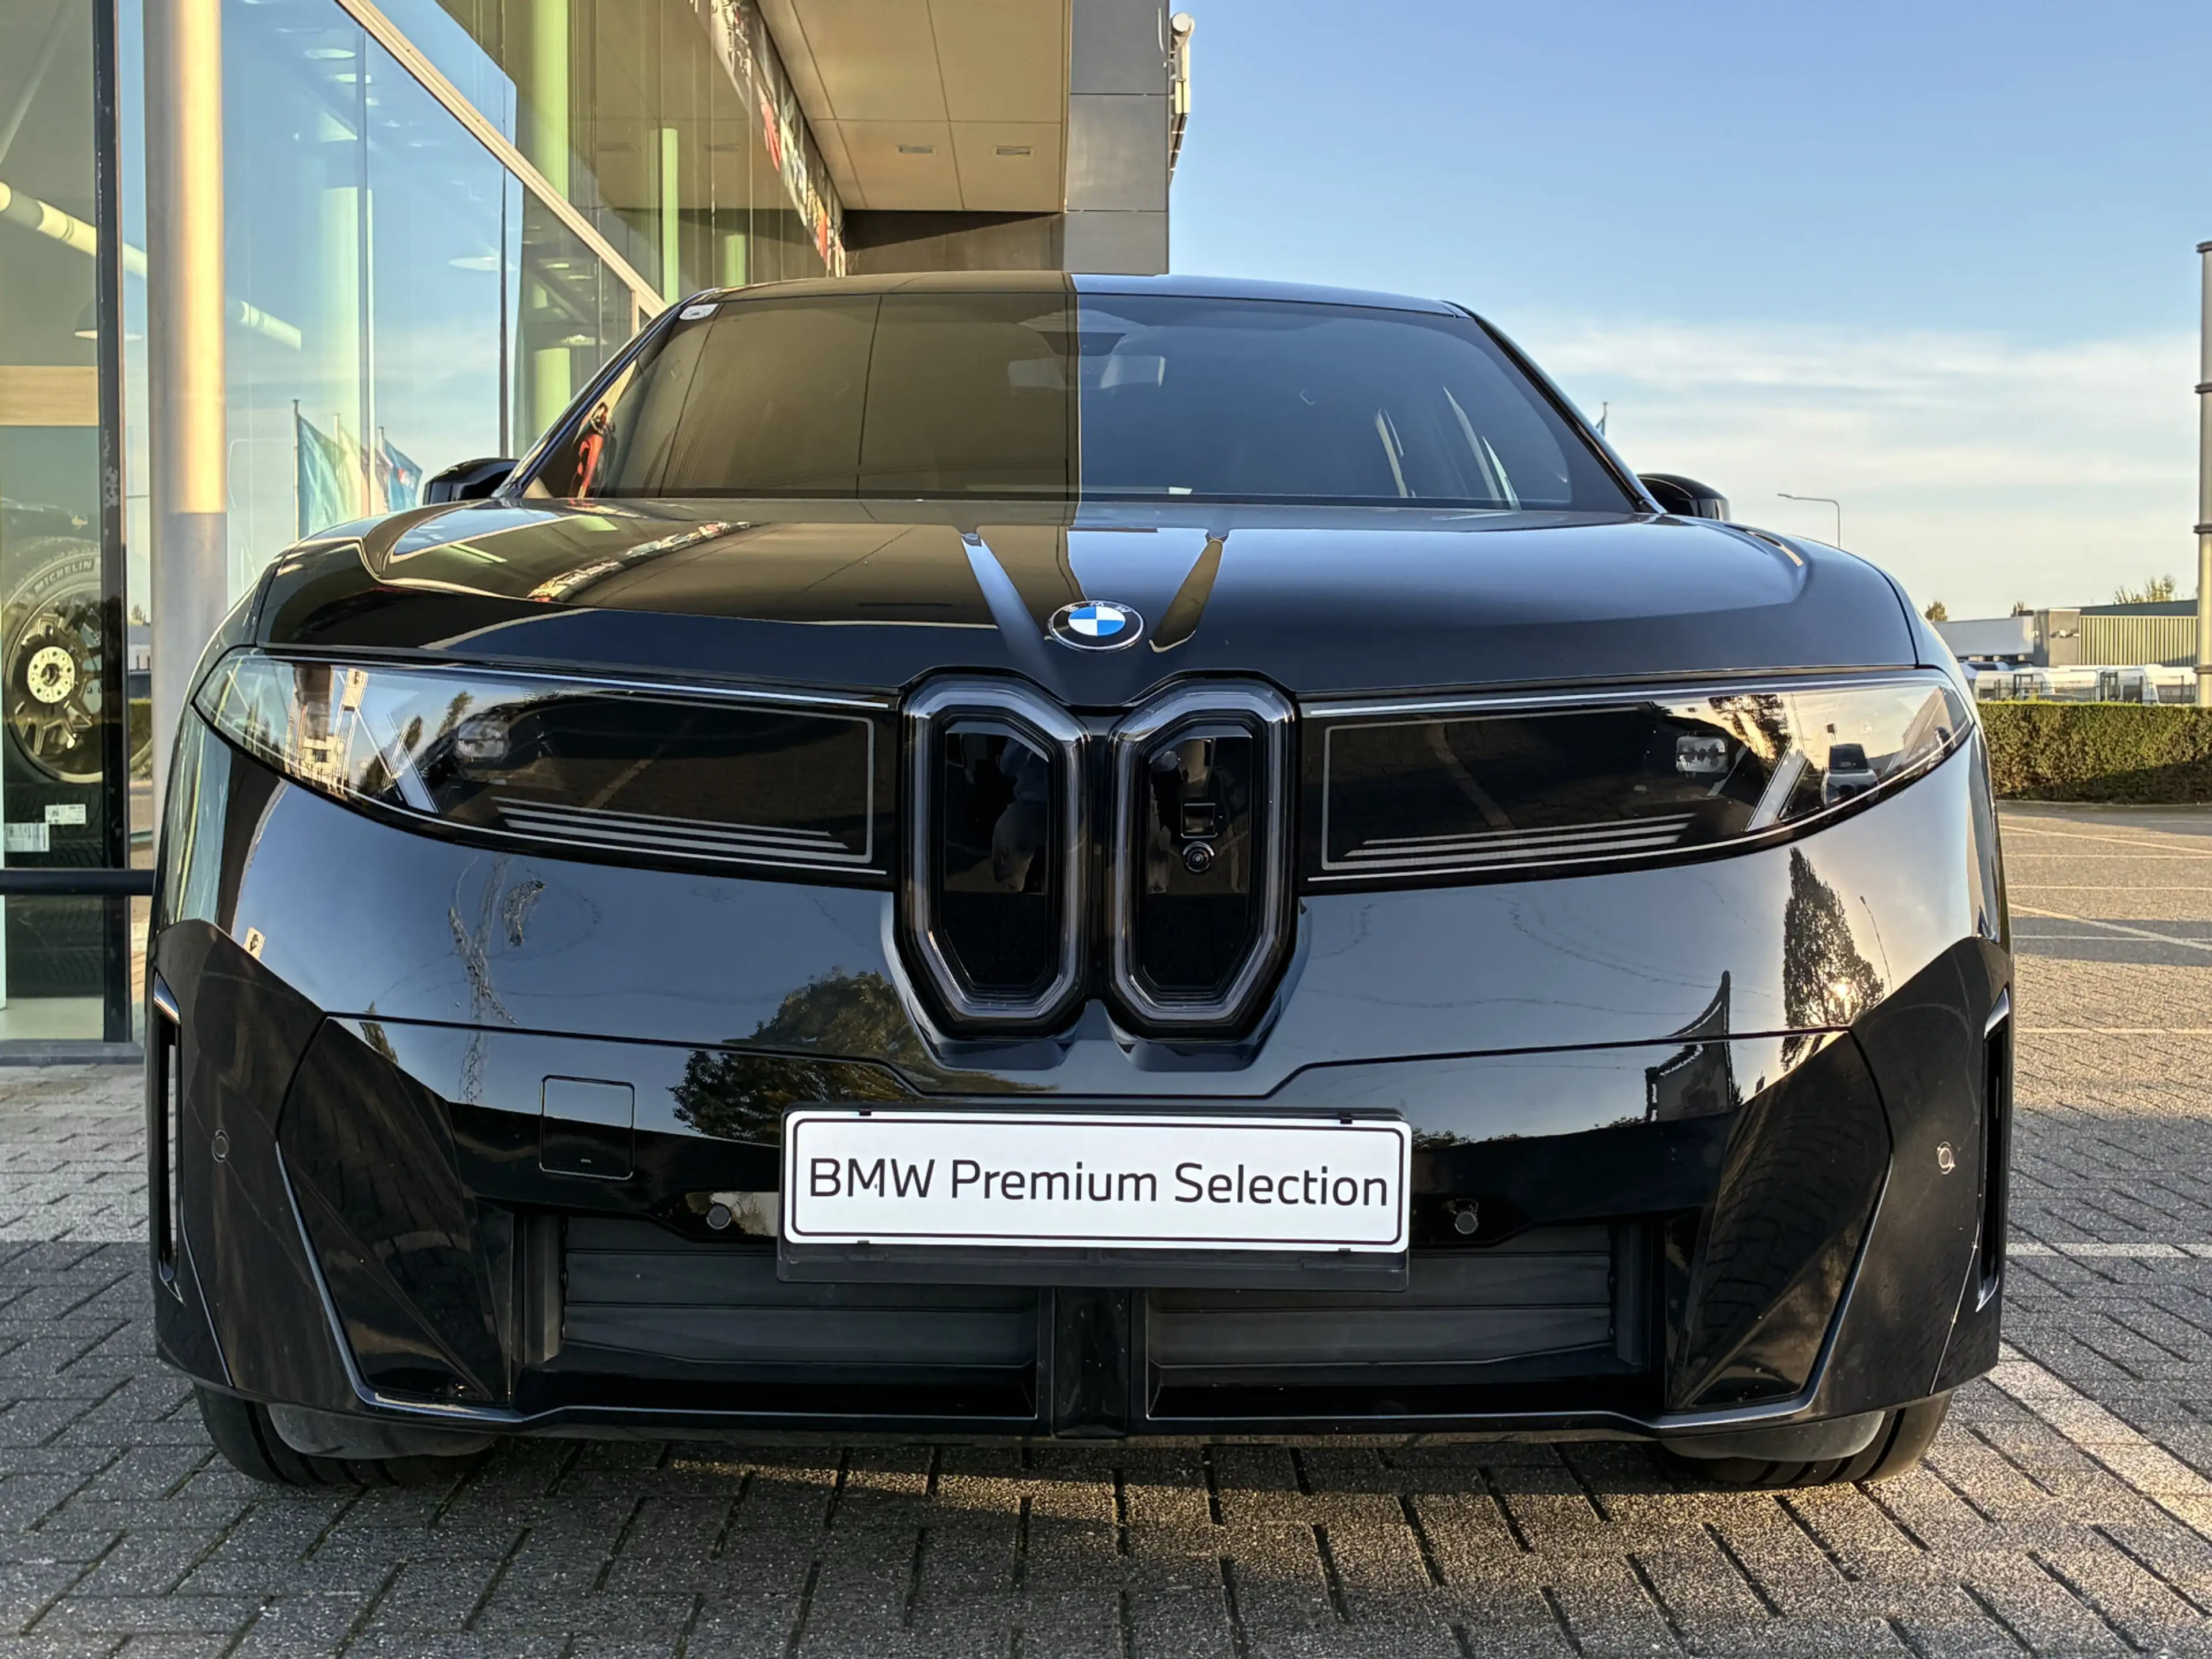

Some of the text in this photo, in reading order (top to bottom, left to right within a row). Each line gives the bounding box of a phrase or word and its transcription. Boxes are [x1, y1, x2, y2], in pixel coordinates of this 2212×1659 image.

[33, 559, 93, 594] MICHELIN
[809, 1157, 1388, 1207] BMW Premium Selection
